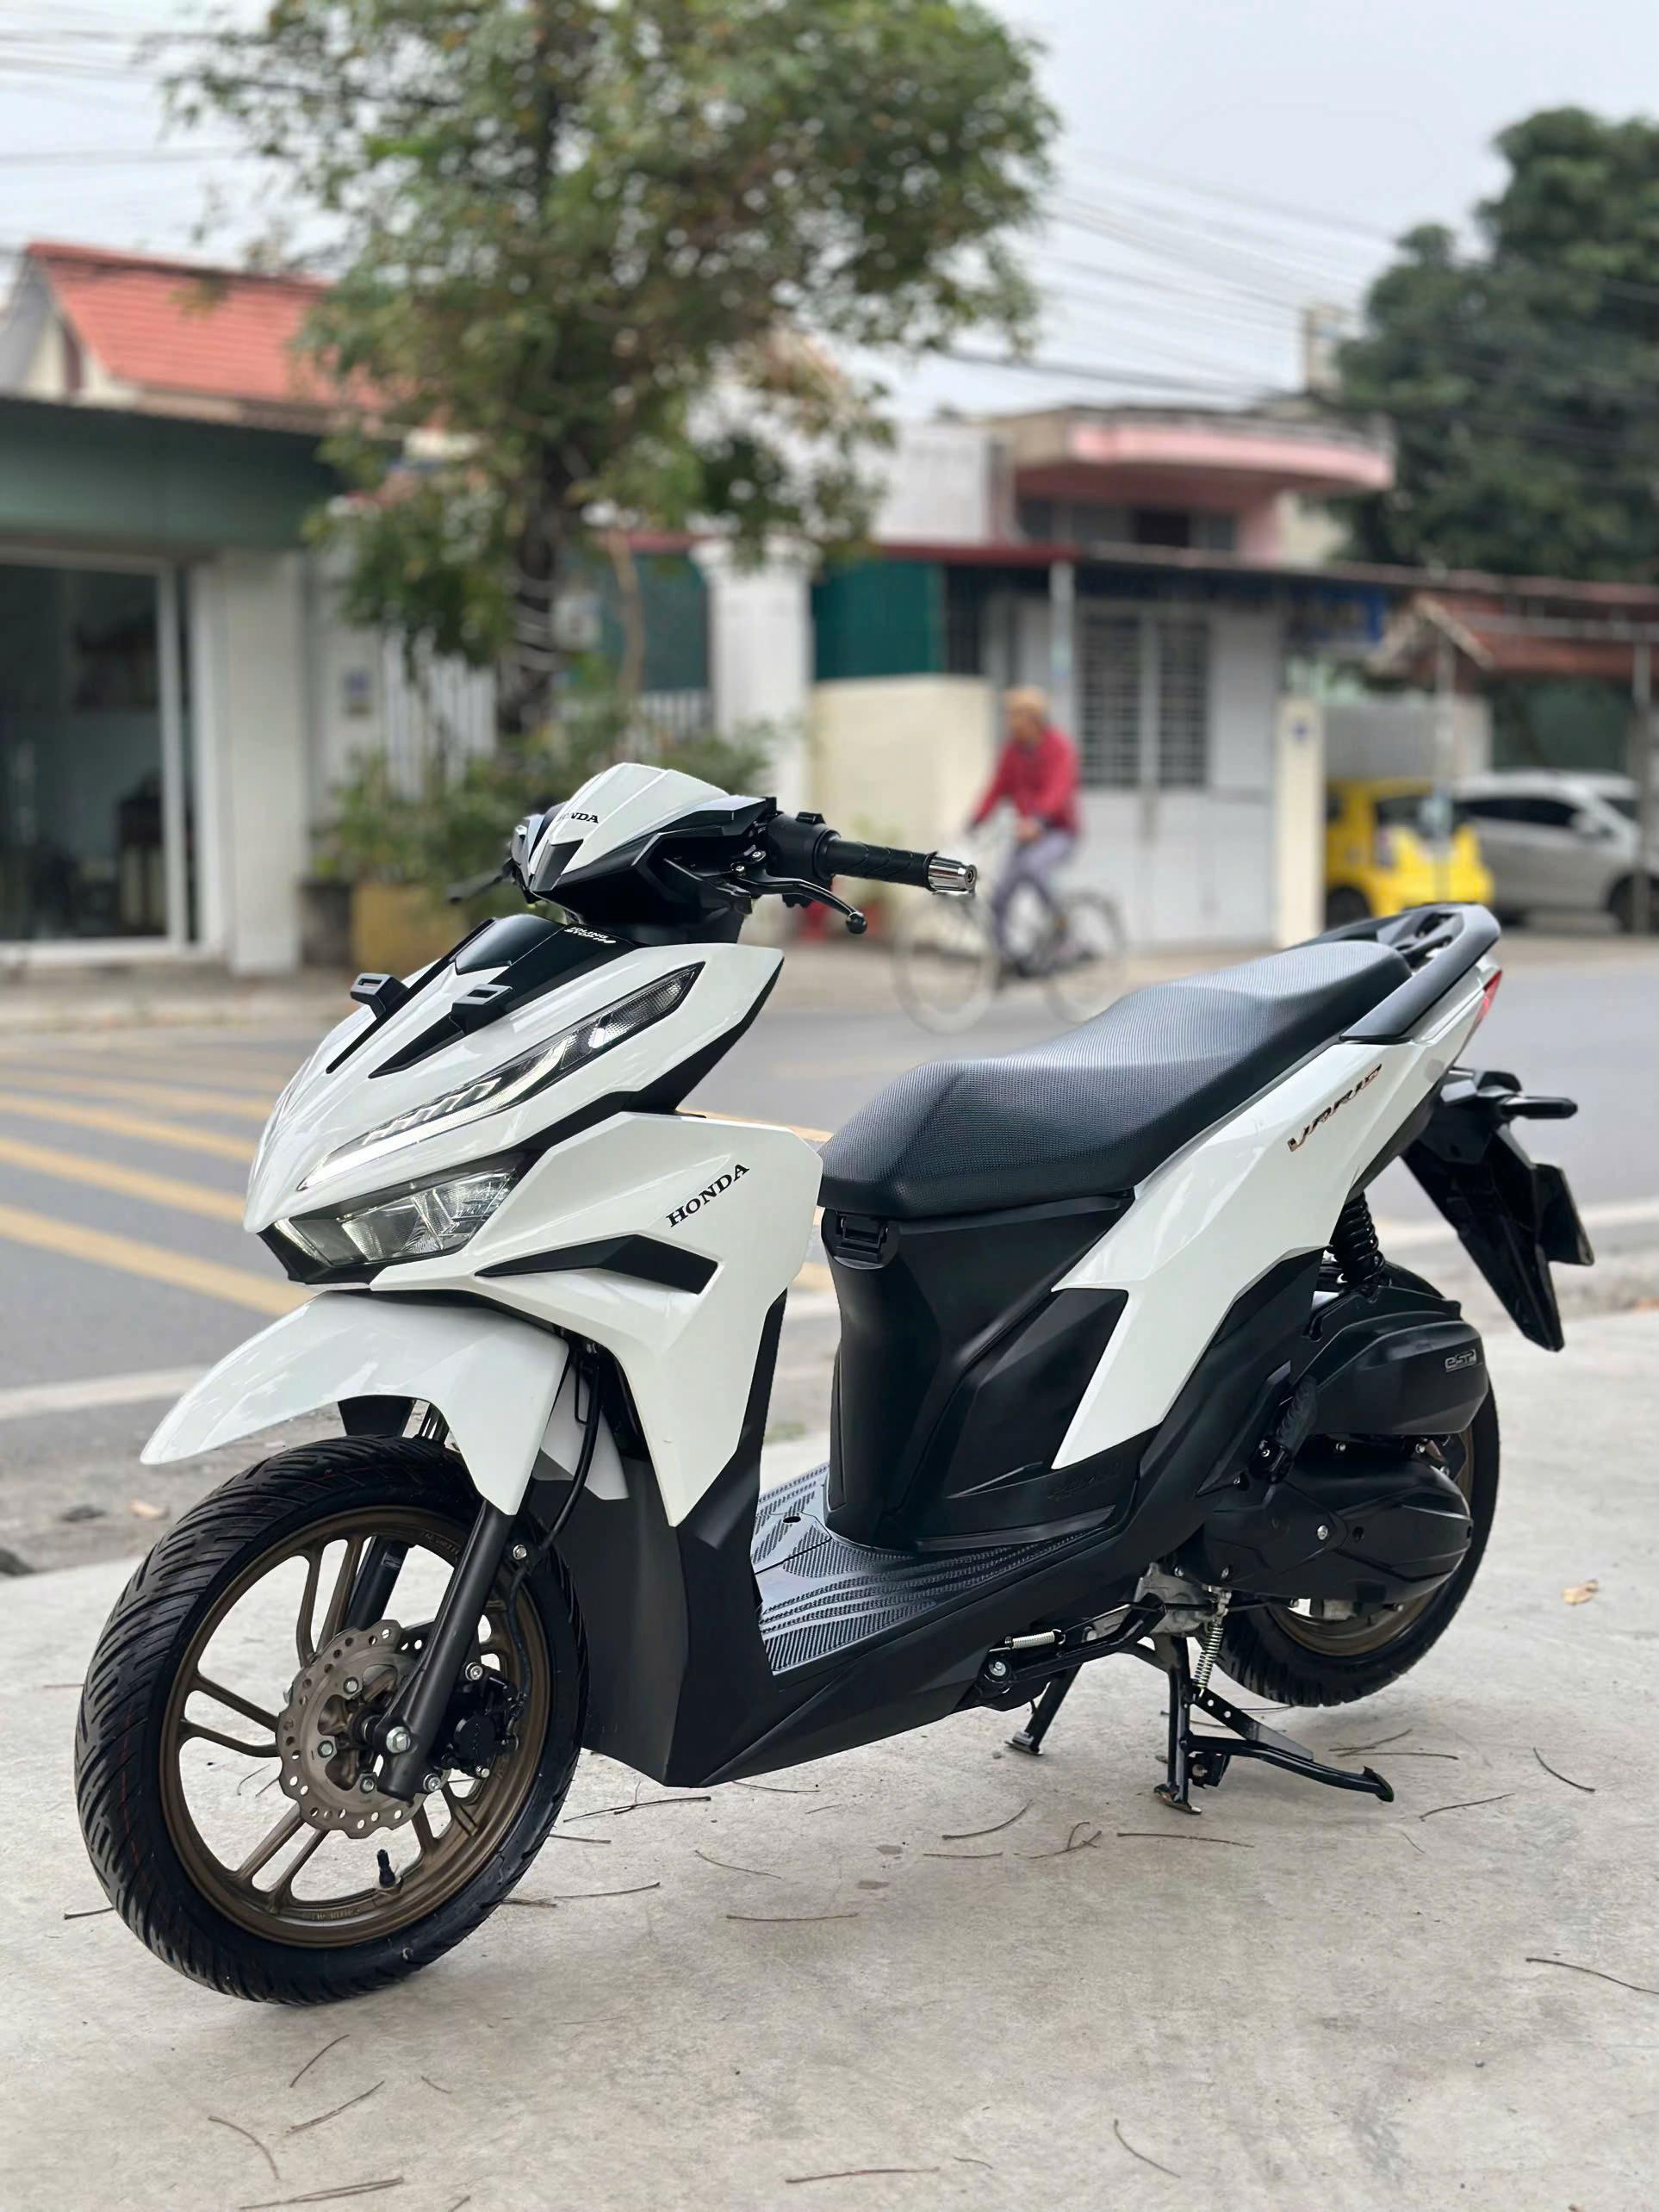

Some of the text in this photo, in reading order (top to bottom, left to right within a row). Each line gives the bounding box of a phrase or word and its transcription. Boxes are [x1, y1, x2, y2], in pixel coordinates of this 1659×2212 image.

[562, 812, 599, 823] NDA
[1287, 1062, 1382, 1153] VARIO
[665, 1164, 750, 1227] HONDA
